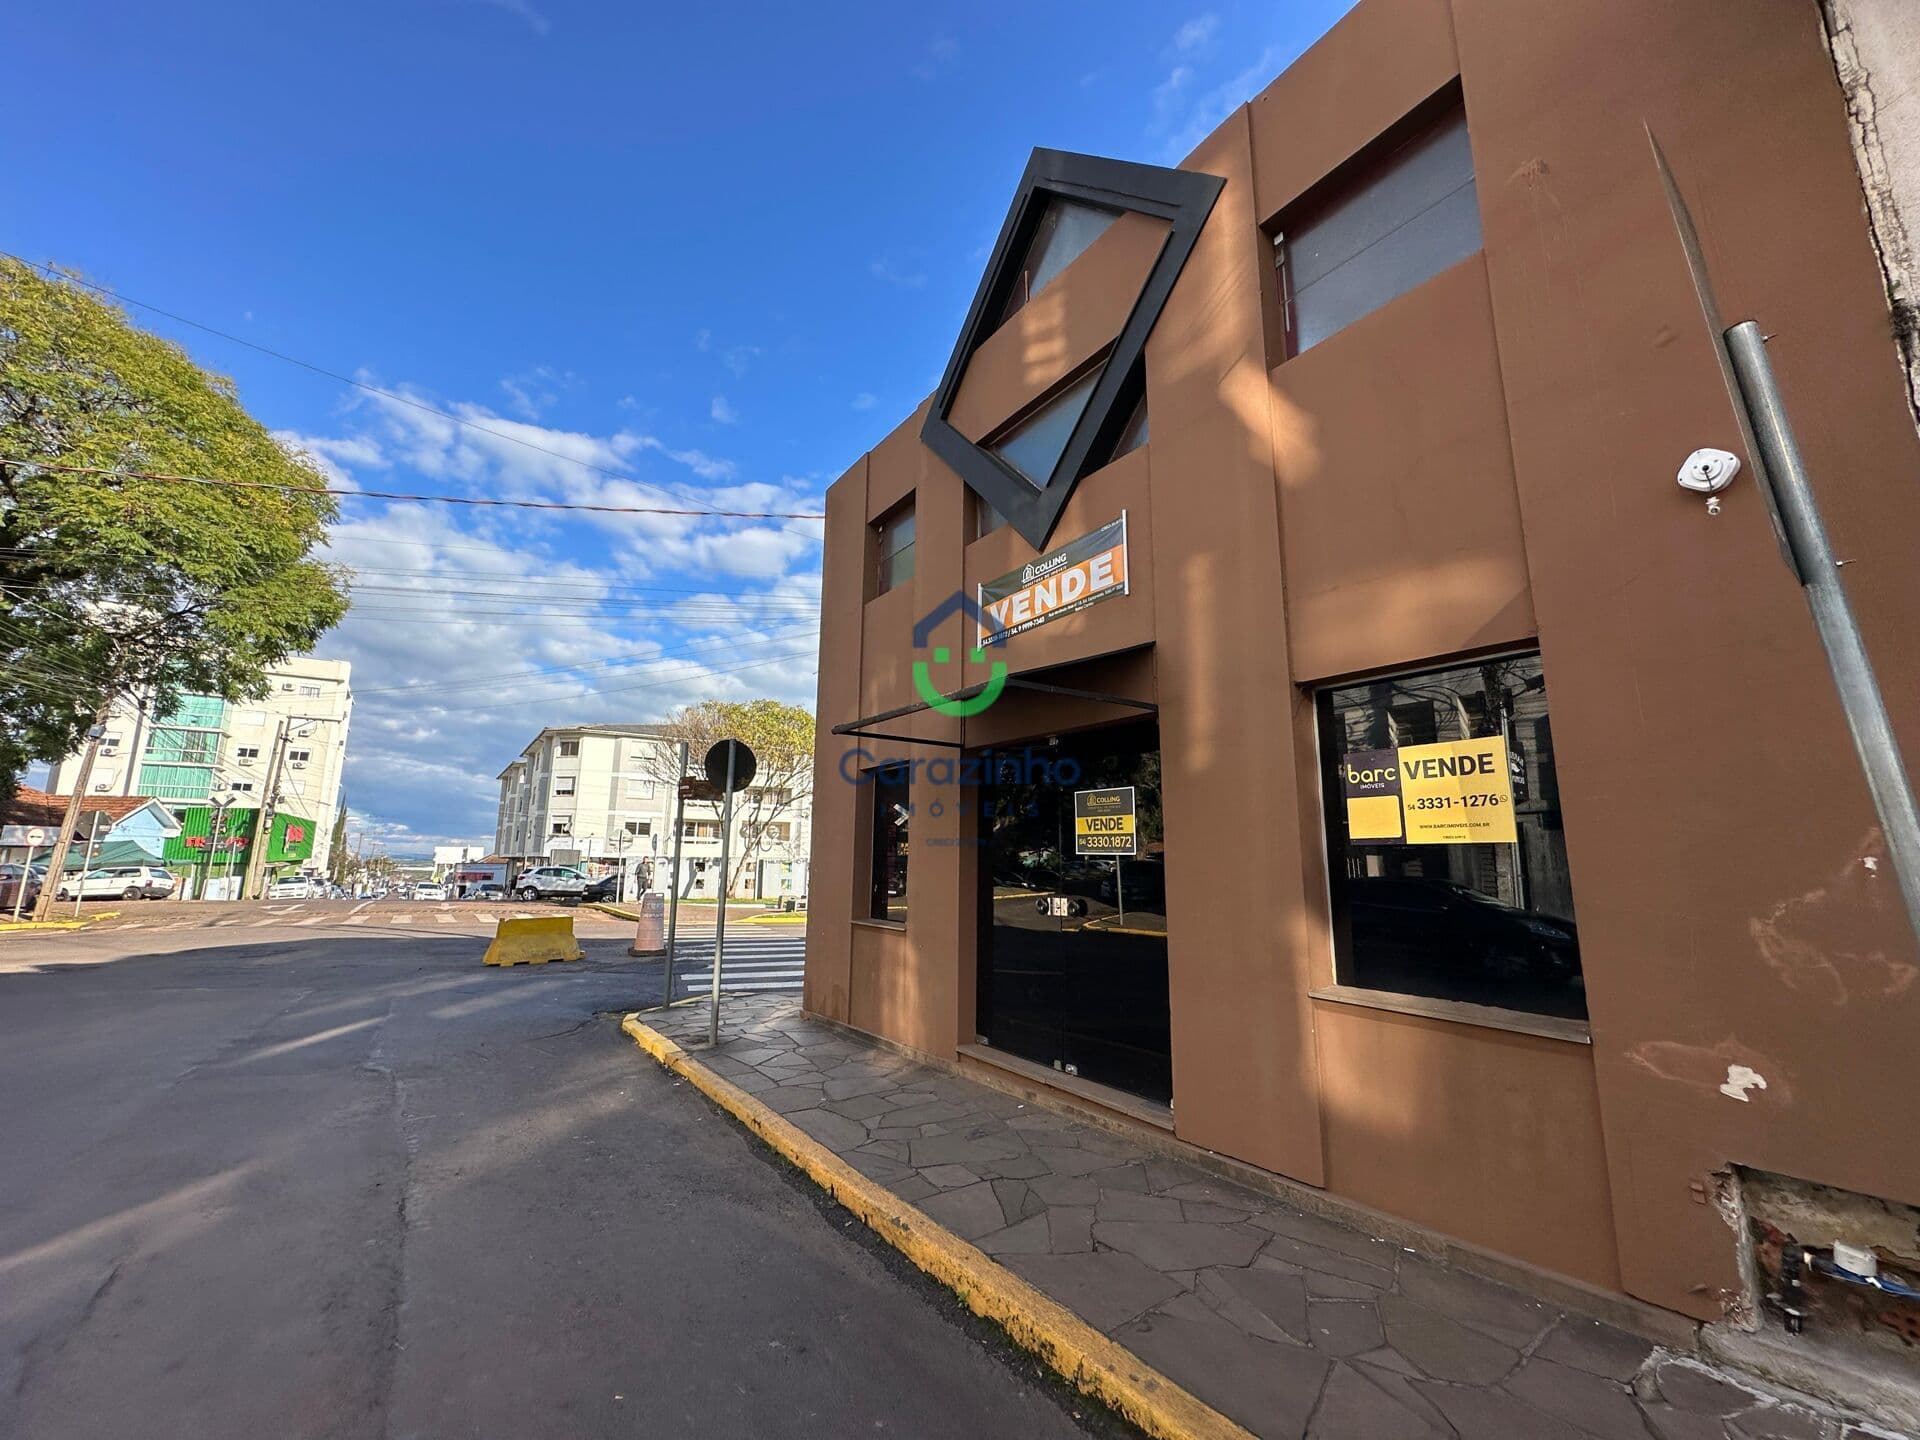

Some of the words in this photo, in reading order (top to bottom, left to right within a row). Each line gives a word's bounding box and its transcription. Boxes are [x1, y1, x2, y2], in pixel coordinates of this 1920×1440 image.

[1035, 553, 1067, 574] COLLING
[989, 551, 1114, 628] VENDE
[1346, 763, 1396, 784] barc
[1404, 753, 1495, 780] VENDE
[1360, 782, 1385, 790] IMÓVEIS
[1407, 803, 1416, 811] 54
[1417, 794, 1499, 811] 3331-1276
[1086, 817, 1123, 831] VENDE
[1088, 836, 1132, 847] 3330.1872
